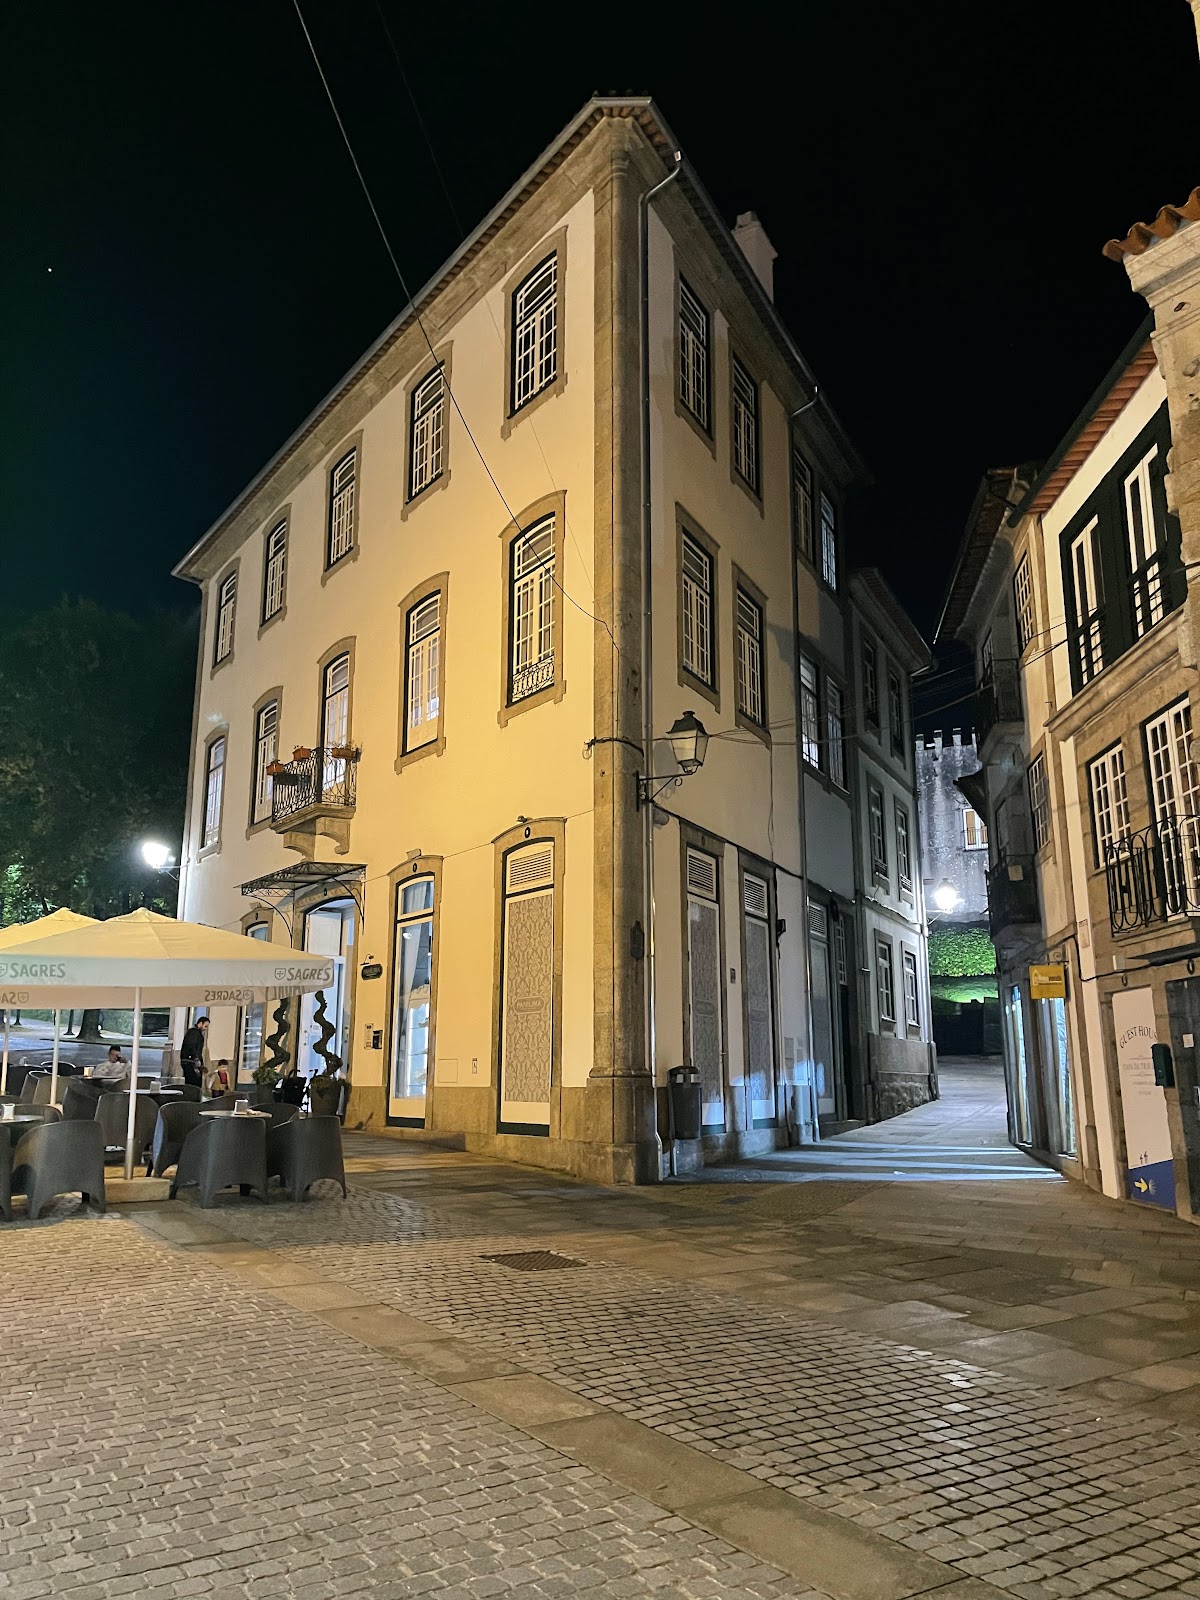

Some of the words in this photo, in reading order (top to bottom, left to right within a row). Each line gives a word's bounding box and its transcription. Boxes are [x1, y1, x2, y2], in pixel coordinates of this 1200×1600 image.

[9, 962, 66, 979] SAGRES
[287, 967, 331, 982] SAGRES
[1120, 1026, 1138, 1049] GUEST
[1138, 1025, 1158, 1042] HOUS
